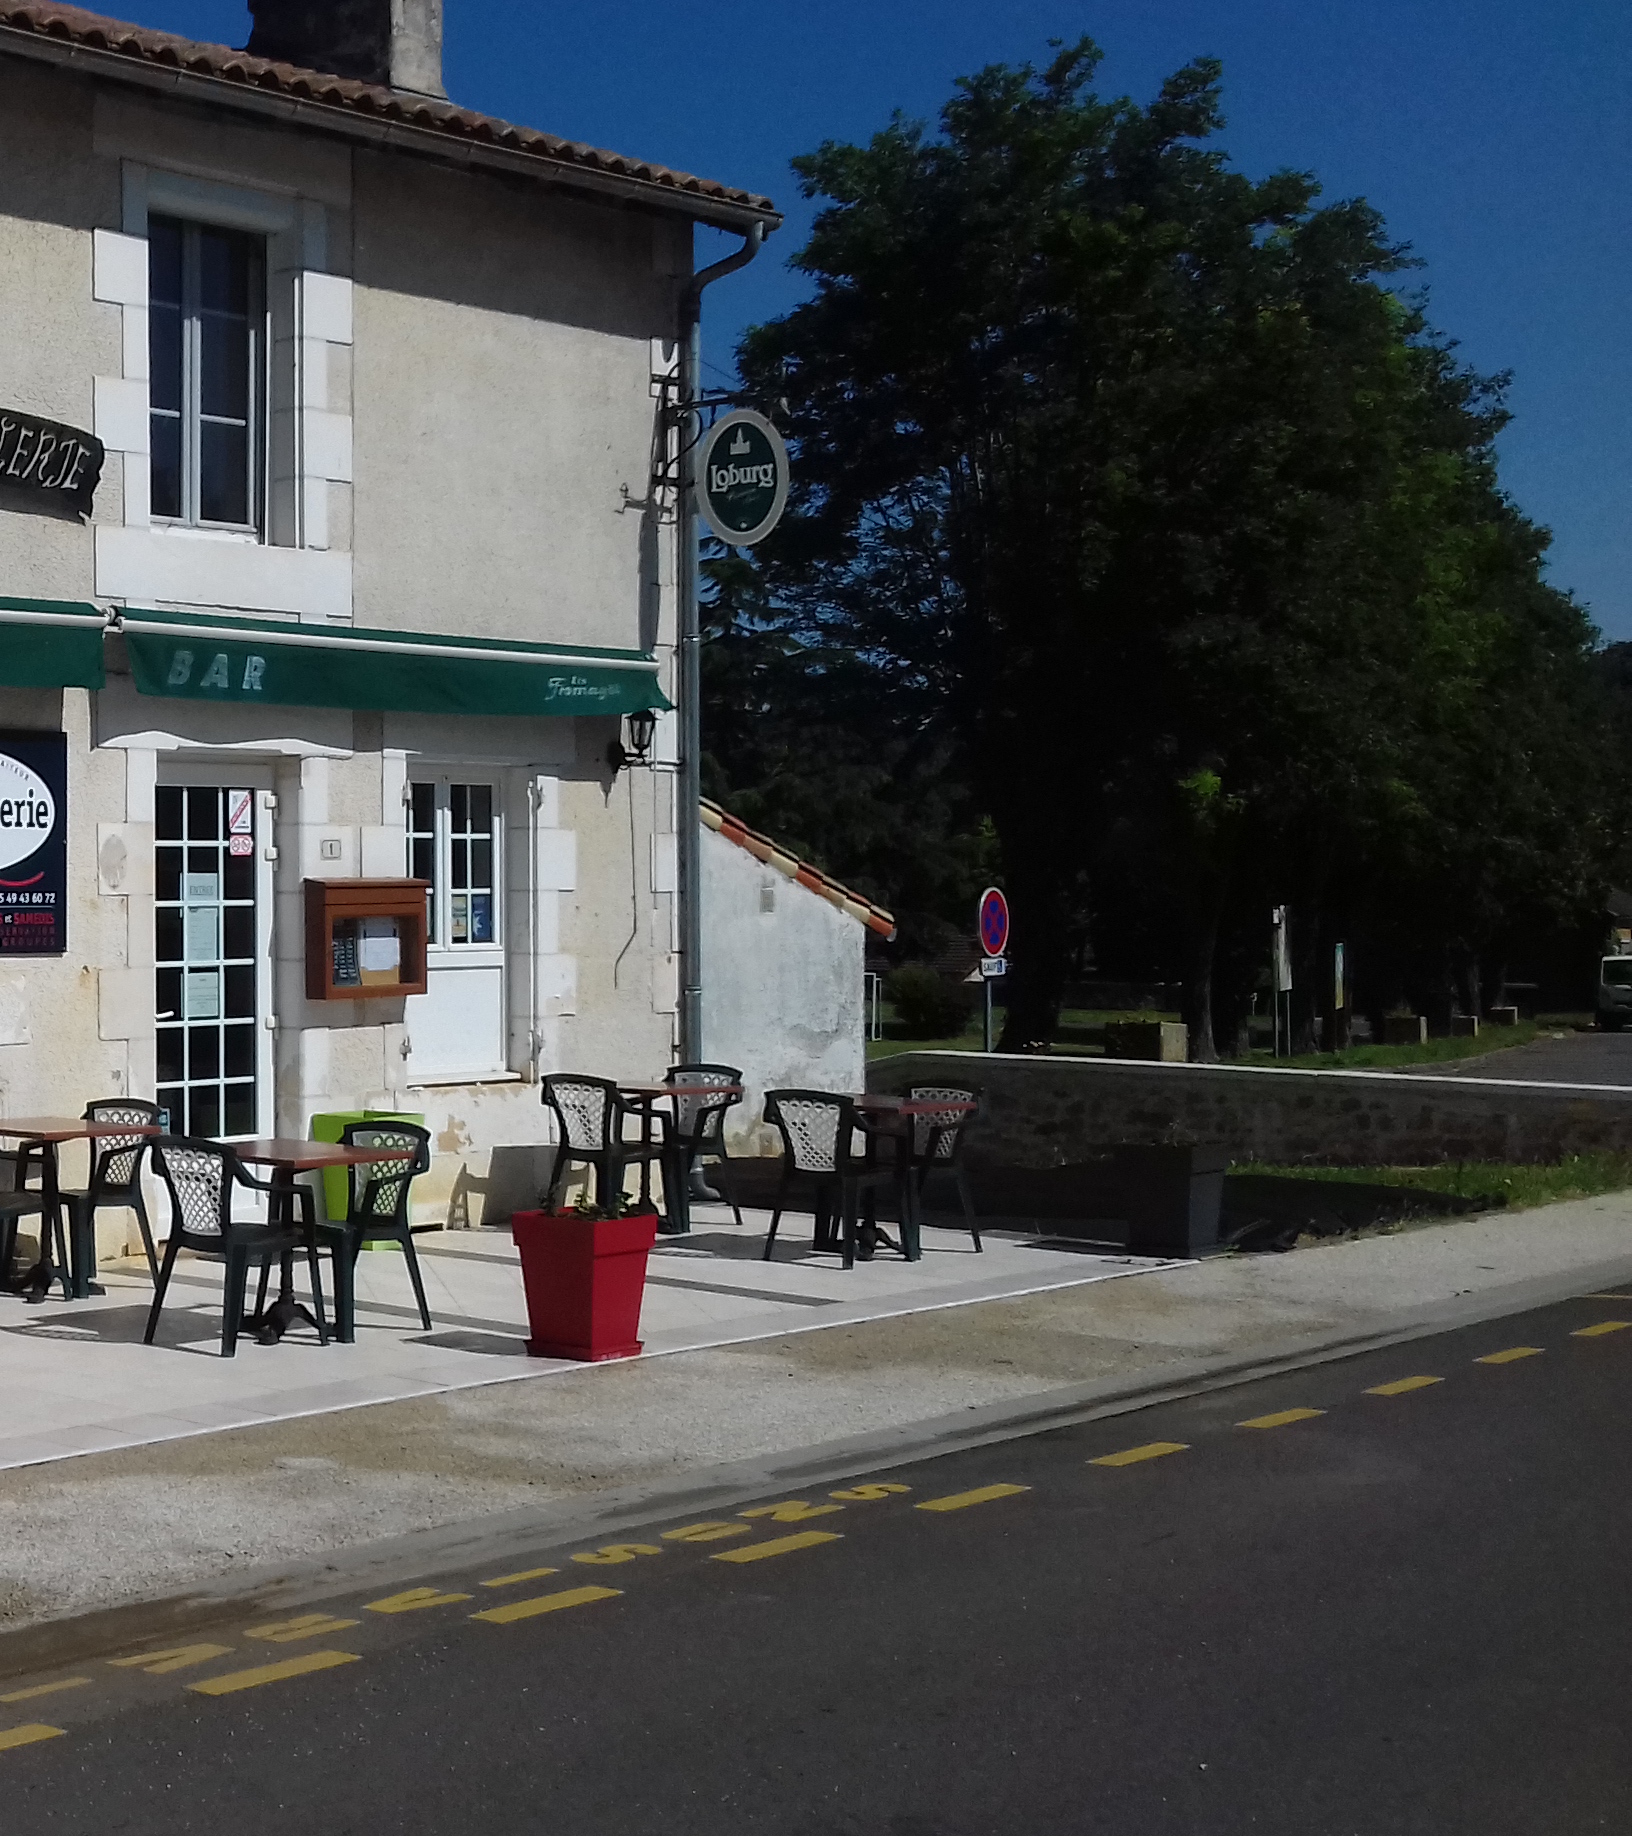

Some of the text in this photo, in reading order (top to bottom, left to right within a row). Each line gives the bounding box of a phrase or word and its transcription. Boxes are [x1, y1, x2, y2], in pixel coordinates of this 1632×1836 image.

[710, 463, 774, 493] Loburg
[167, 650, 266, 690] BAR
[6, 892, 18, 904] 49
[19, 892, 29, 904] 43
[32, 892, 43, 904] 60
[45, 892, 56, 904] 72
[13, 912, 55, 925] SAMEDIS
